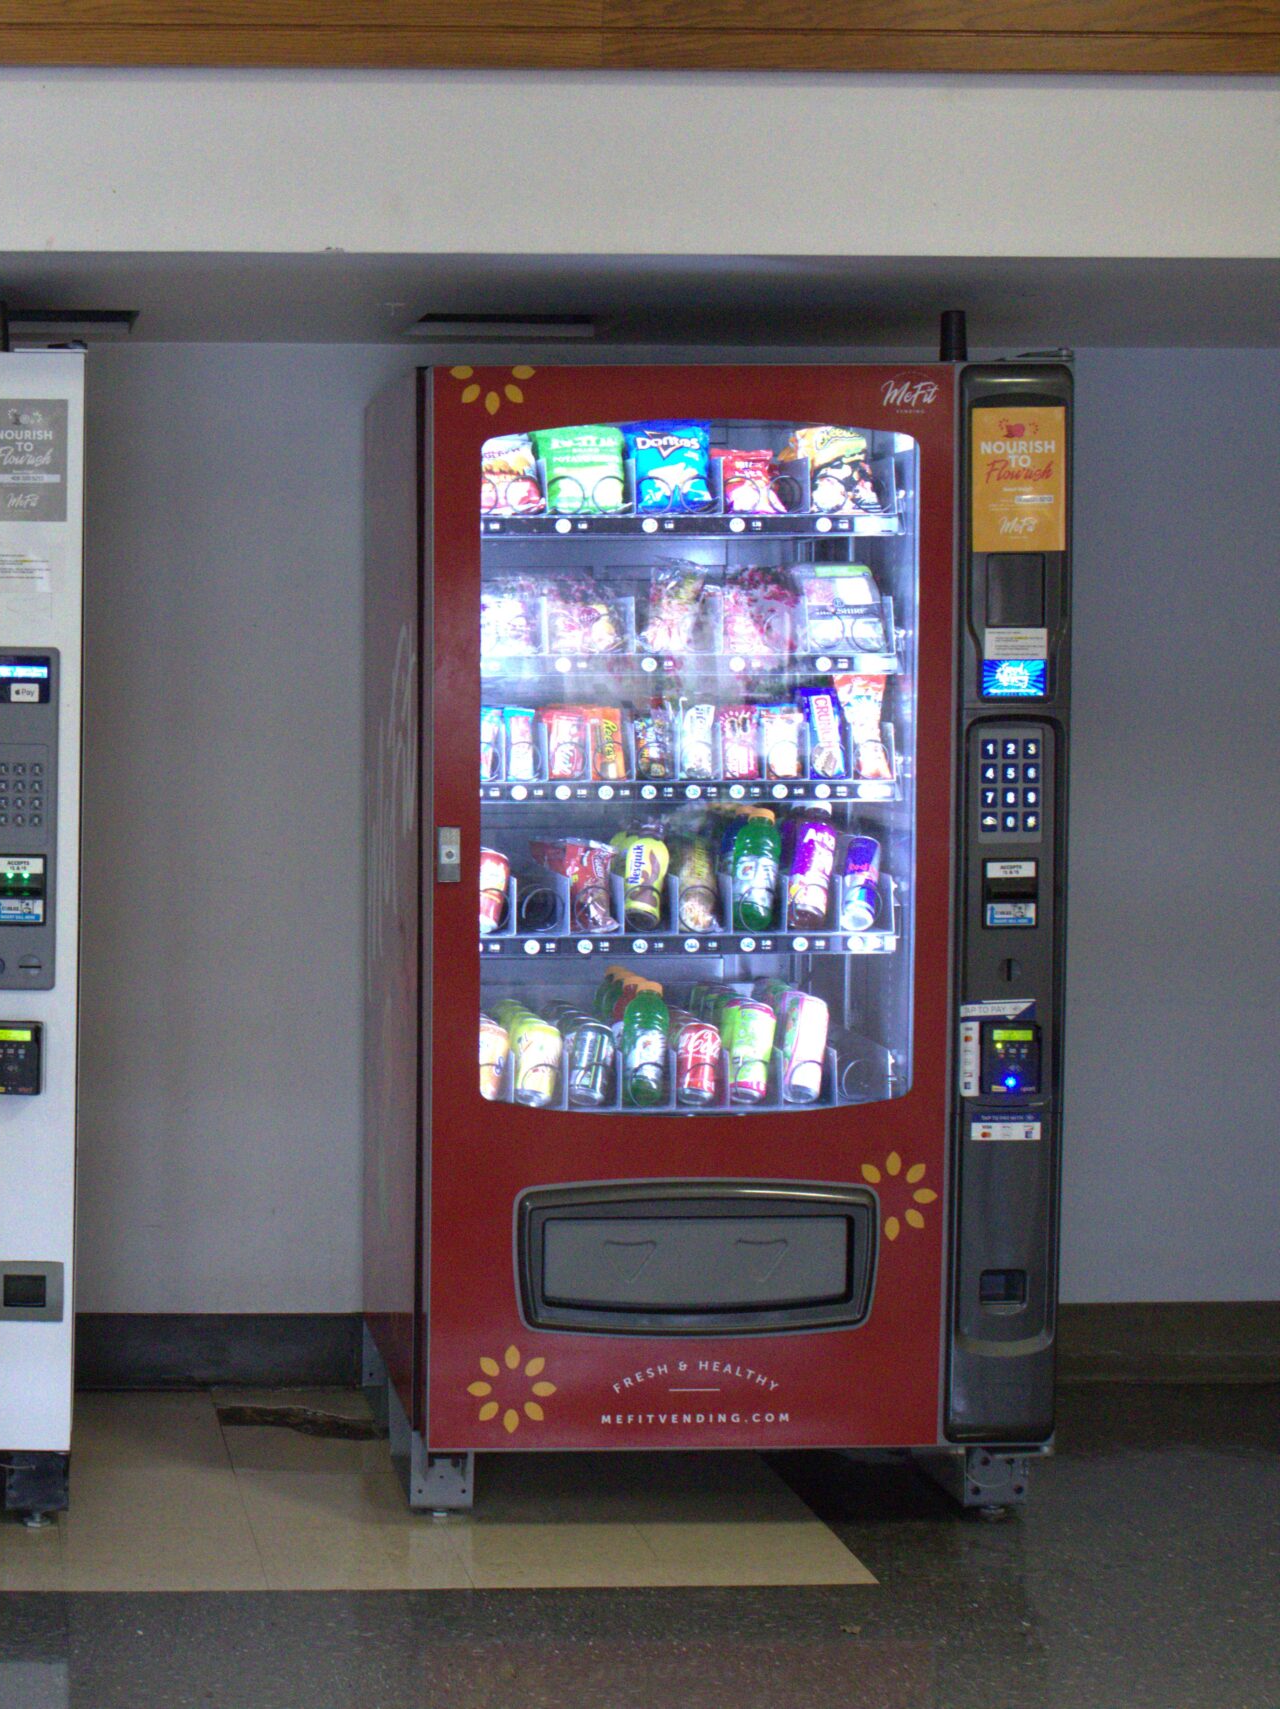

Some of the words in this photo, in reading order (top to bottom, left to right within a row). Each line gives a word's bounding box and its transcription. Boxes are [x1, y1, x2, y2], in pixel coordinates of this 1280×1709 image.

[880, 380, 940, 407] MeFit
[15, 441, 34, 452] TO
[636, 435, 700, 450] Doritos
[980, 440, 1056, 454] NOURISH
[1008, 454, 1032, 468] TO
[985, 459, 1054, 484] Flourish
[21, 688, 35, 697] Pay
[986, 743, 994, 755] 1
[1006, 743, 1016, 755] 2
[1027, 743, 1036, 755] 3
[985, 767, 995, 779] 4
[1006, 767, 1015, 779] 5
[1027, 767, 1036, 779] 6
[985, 791, 995, 803] 7
[1006, 791, 1015, 803] 8
[1027, 791, 1036, 803] 9
[1006, 816, 1015, 828] 0
[627, 844, 645, 885] Nesquik
[736, 861, 755, 880] G
[991, 1005, 1006, 1013] PAY
[613, 1364, 668, 1394] FRESH
[678, 1360, 688, 1371] &
[699, 1360, 779, 1391] HEALTHY
[601, 1413, 790, 1424] MEFITVENDING.COM
